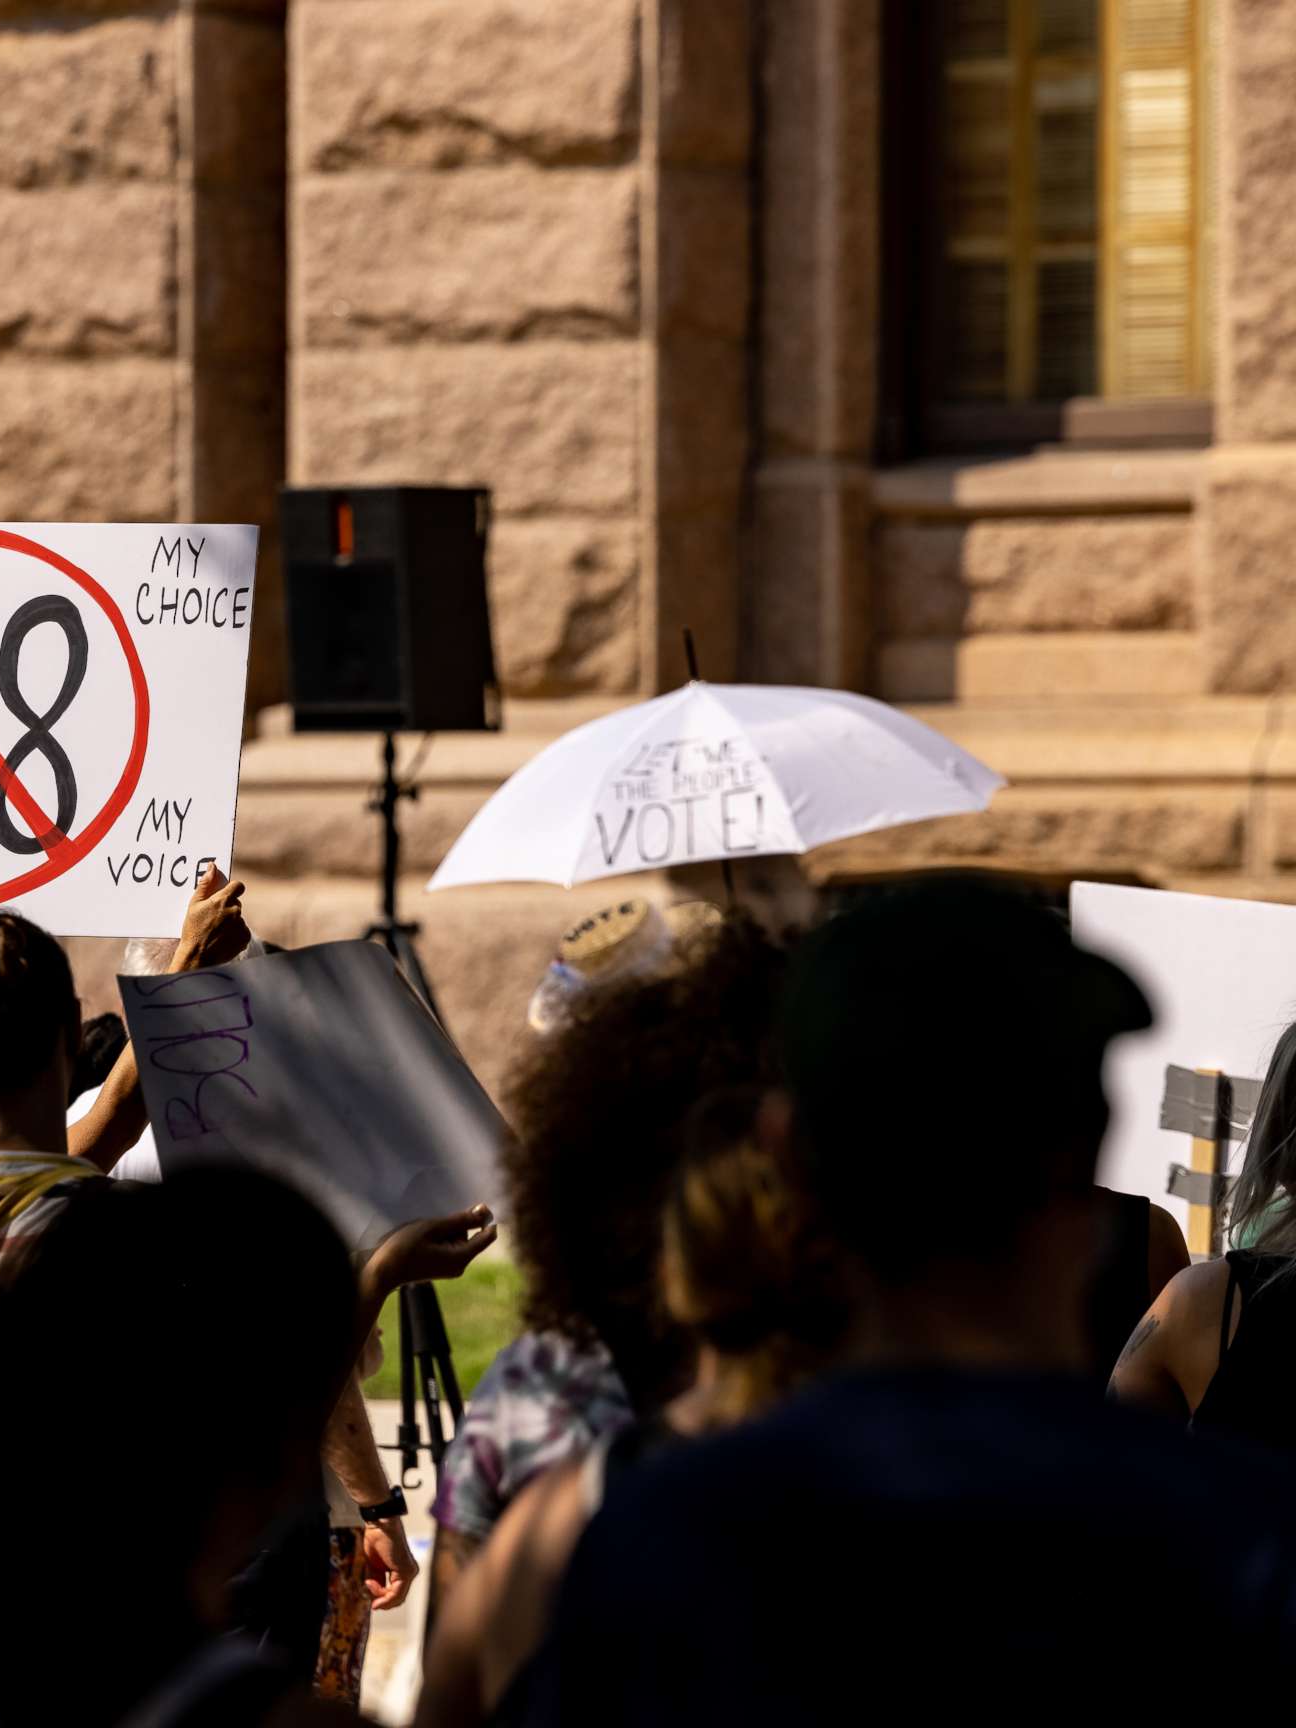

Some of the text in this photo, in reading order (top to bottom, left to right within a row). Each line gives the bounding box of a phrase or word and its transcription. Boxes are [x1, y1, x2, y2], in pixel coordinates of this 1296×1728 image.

[152, 536, 206, 577] MY
[135, 582, 250, 629] CHOICE
[612, 777, 657, 801] THE
[135, 797, 193, 844] MY
[594, 785, 765, 866] VOTE!
